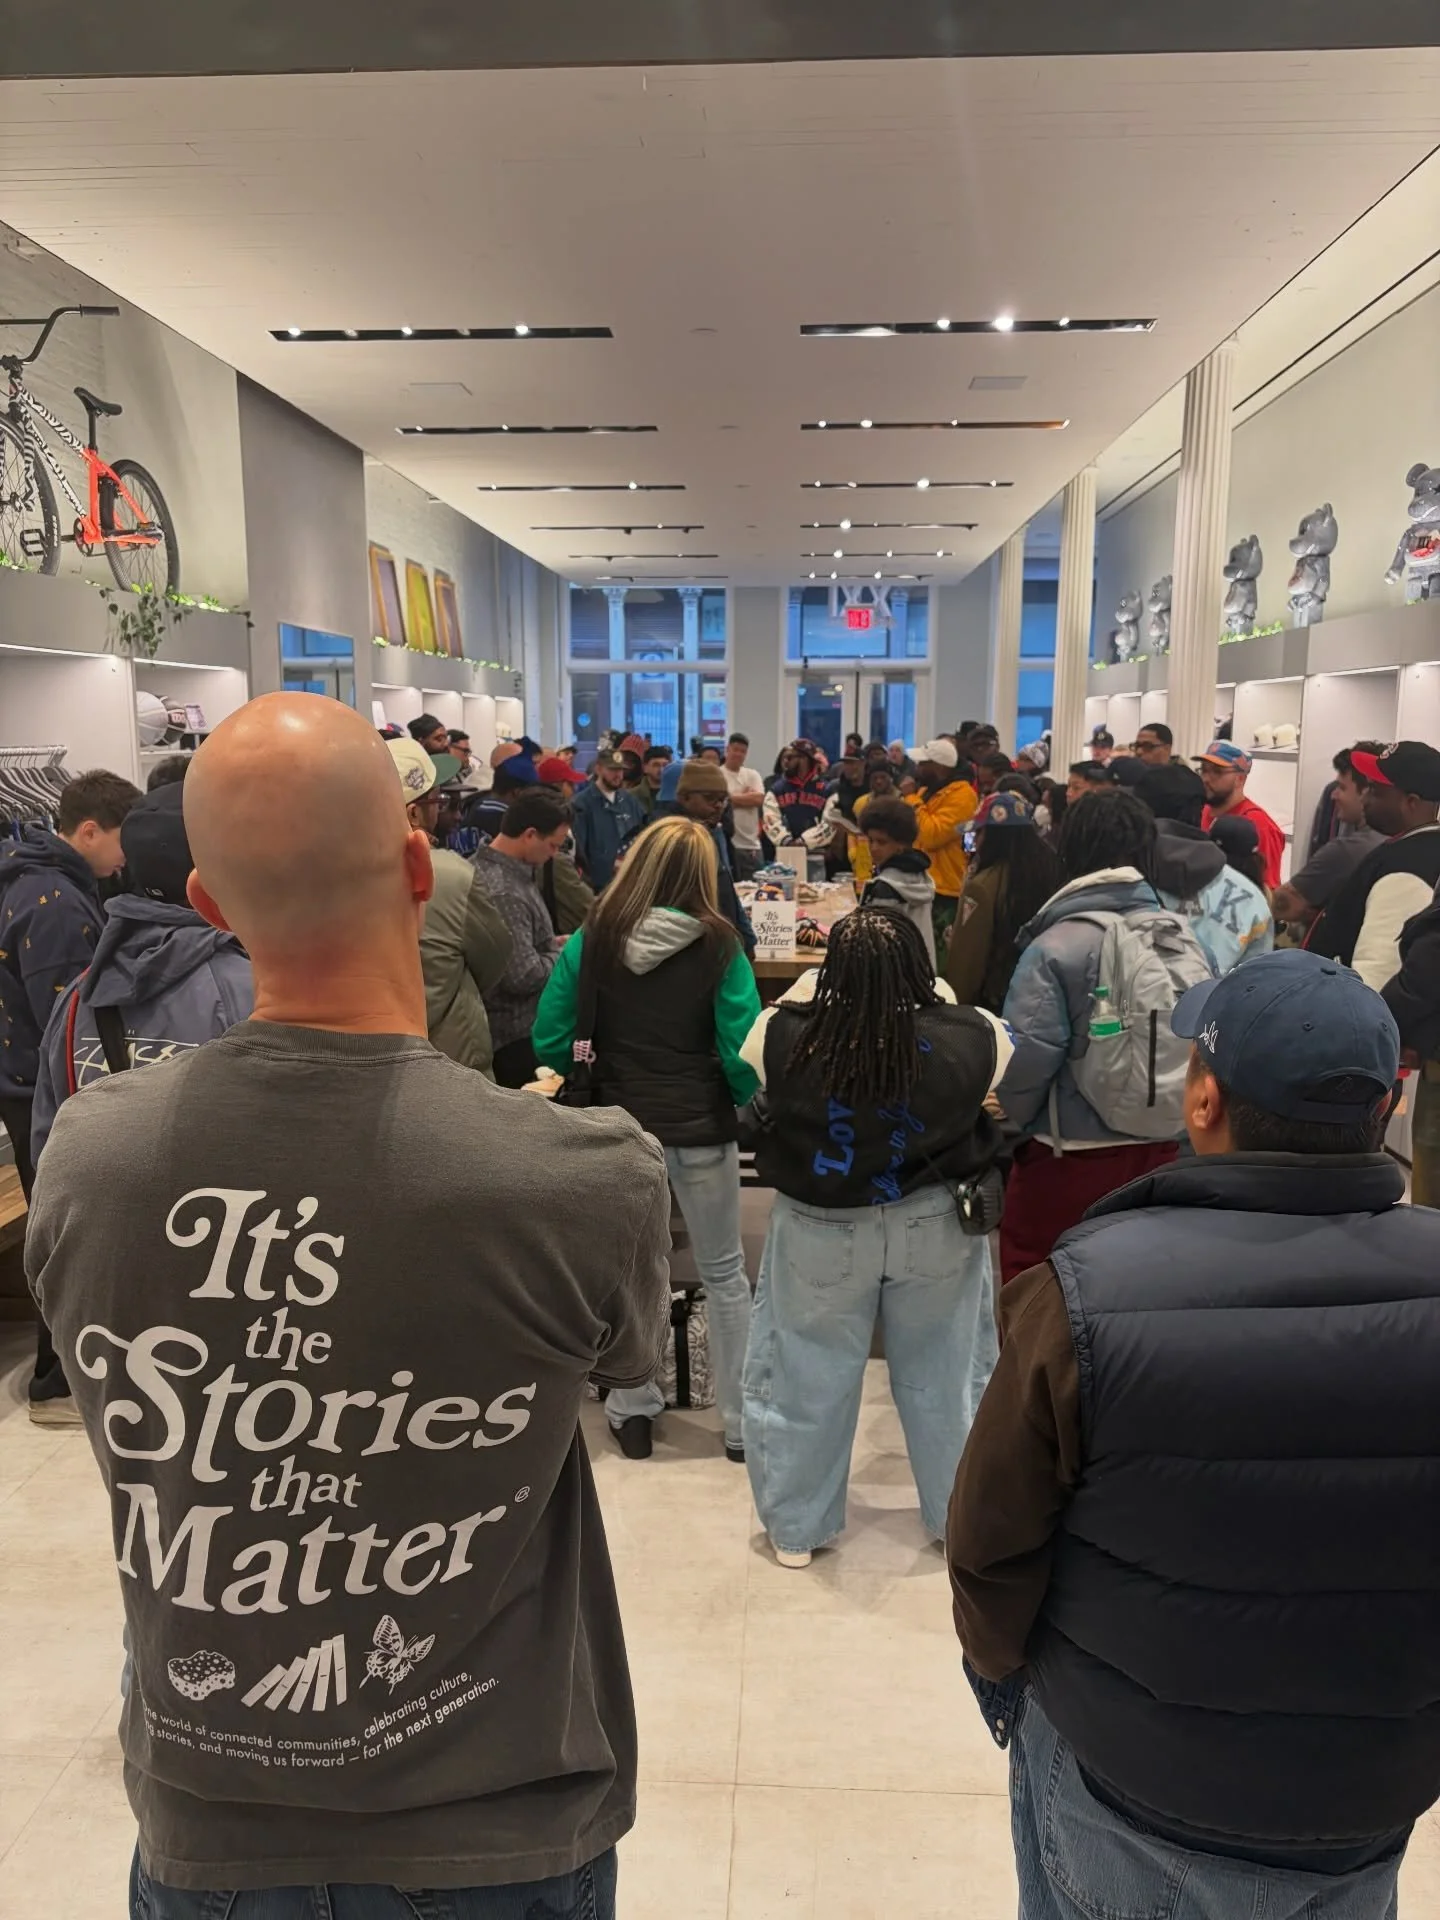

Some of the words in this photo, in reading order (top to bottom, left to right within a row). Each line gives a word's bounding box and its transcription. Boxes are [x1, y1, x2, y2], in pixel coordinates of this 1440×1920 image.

[754, 921, 792, 935] Stories
[758, 935, 793, 946] Matter
[1210, 878, 1254, 934] K
[812, 1094, 855, 1177] Lov
[165, 1187, 345, 1306] It's
[245, 1306, 332, 1372] the
[75, 1324, 537, 1483] Stories
[250, 1454, 362, 1517] that
[116, 1482, 507, 1615] Matter
[157, 1729, 196, 1749] stories,
[200, 1741, 222, 1755] and
[226, 1748, 270, 1766] moving
[273, 1756, 287, 1766] us
[291, 1753, 345, 1767] forward
[363, 1743, 382, 1760] for
[384, 1732, 404, 1751] the
[406, 1712, 432, 1738] next
[434, 1676, 500, 1724] generation.
[160, 1713, 192, 1732] world
[195, 1725, 207, 1736] of
[210, 1730, 273, 1748] connected
[277, 1735, 361, 1751] communities,
[364, 1694, 428, 1739] celebrating
[429, 1671, 473, 1701] culture,
